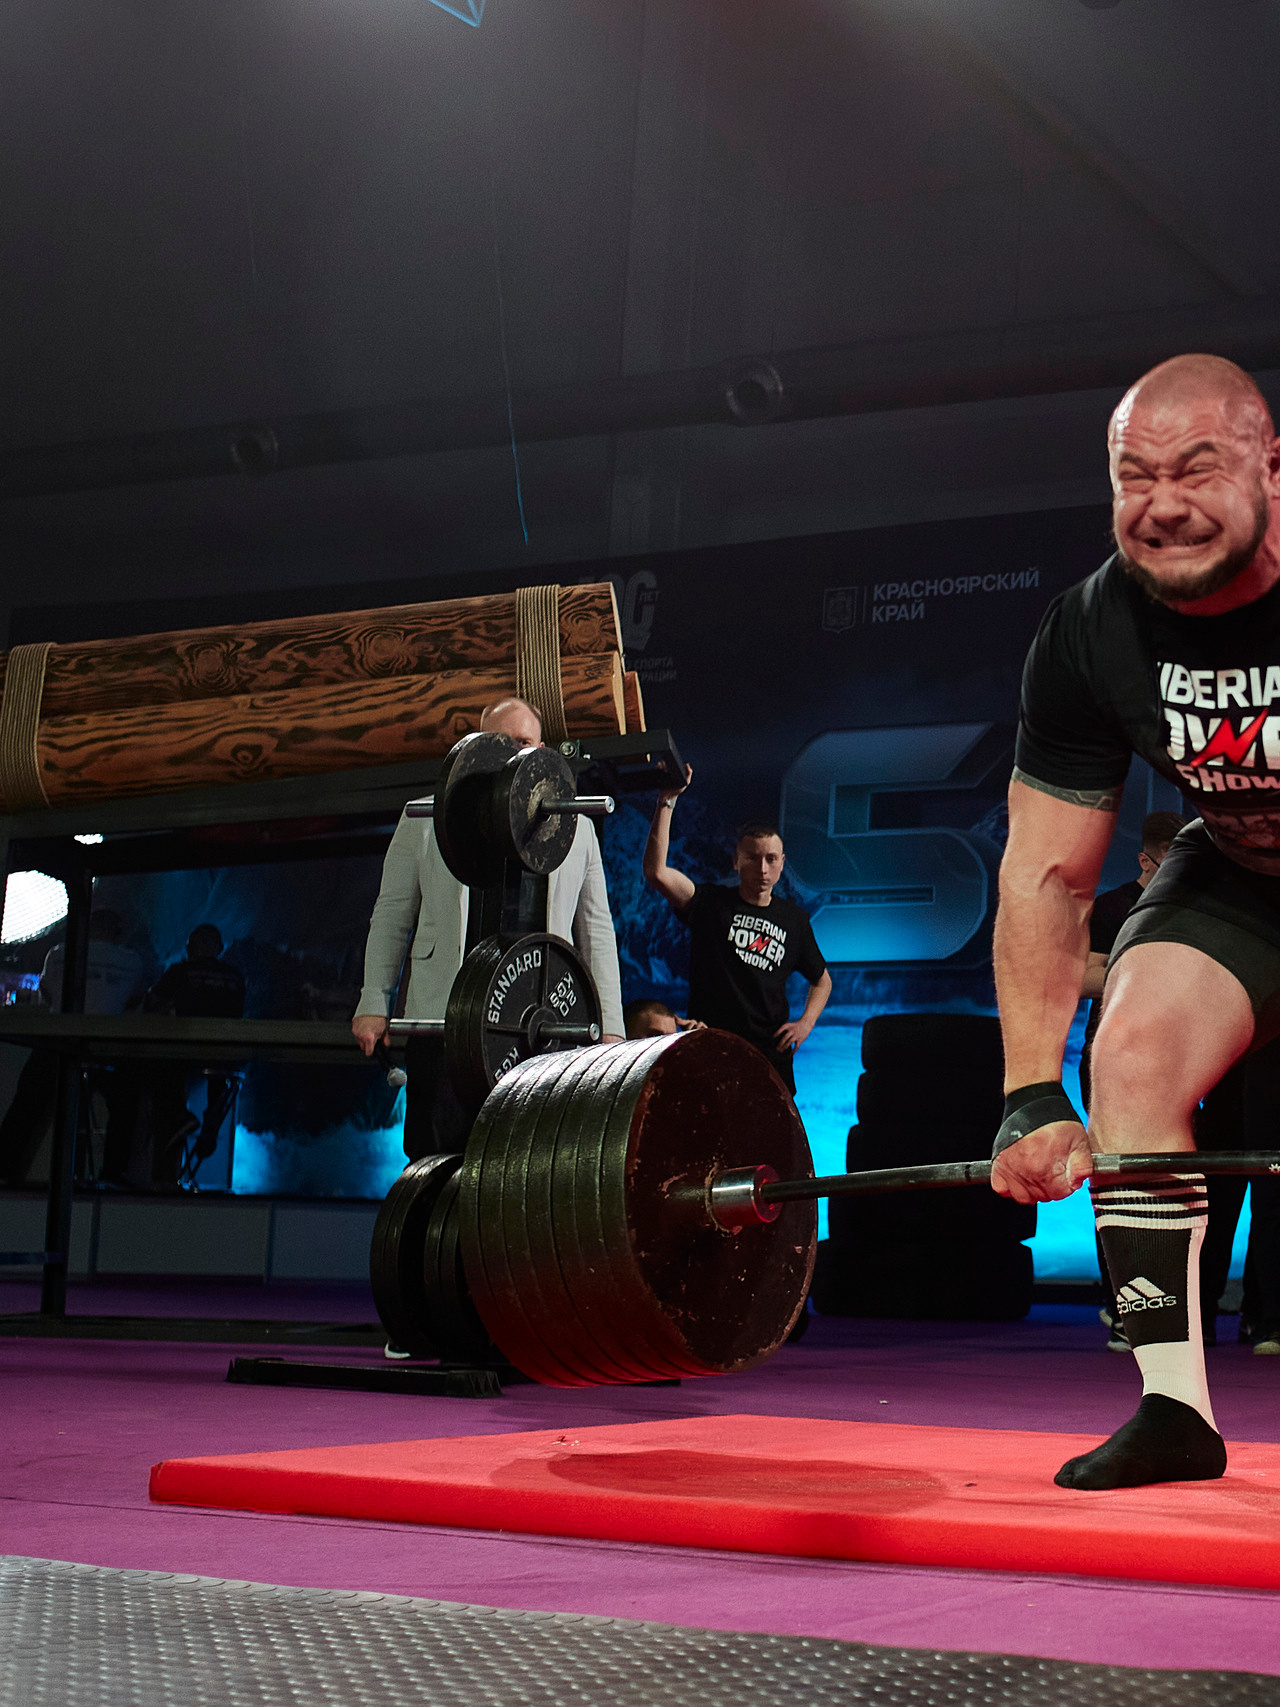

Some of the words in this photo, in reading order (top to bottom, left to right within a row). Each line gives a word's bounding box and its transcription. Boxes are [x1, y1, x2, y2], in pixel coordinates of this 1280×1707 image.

[872, 567, 1040, 602] КРАСНОЯРСКИЙ
[872, 600, 925, 623] КРАЙ
[732, 913, 787, 944] SIBERIAN
[487, 949, 543, 1024] STANDARD
